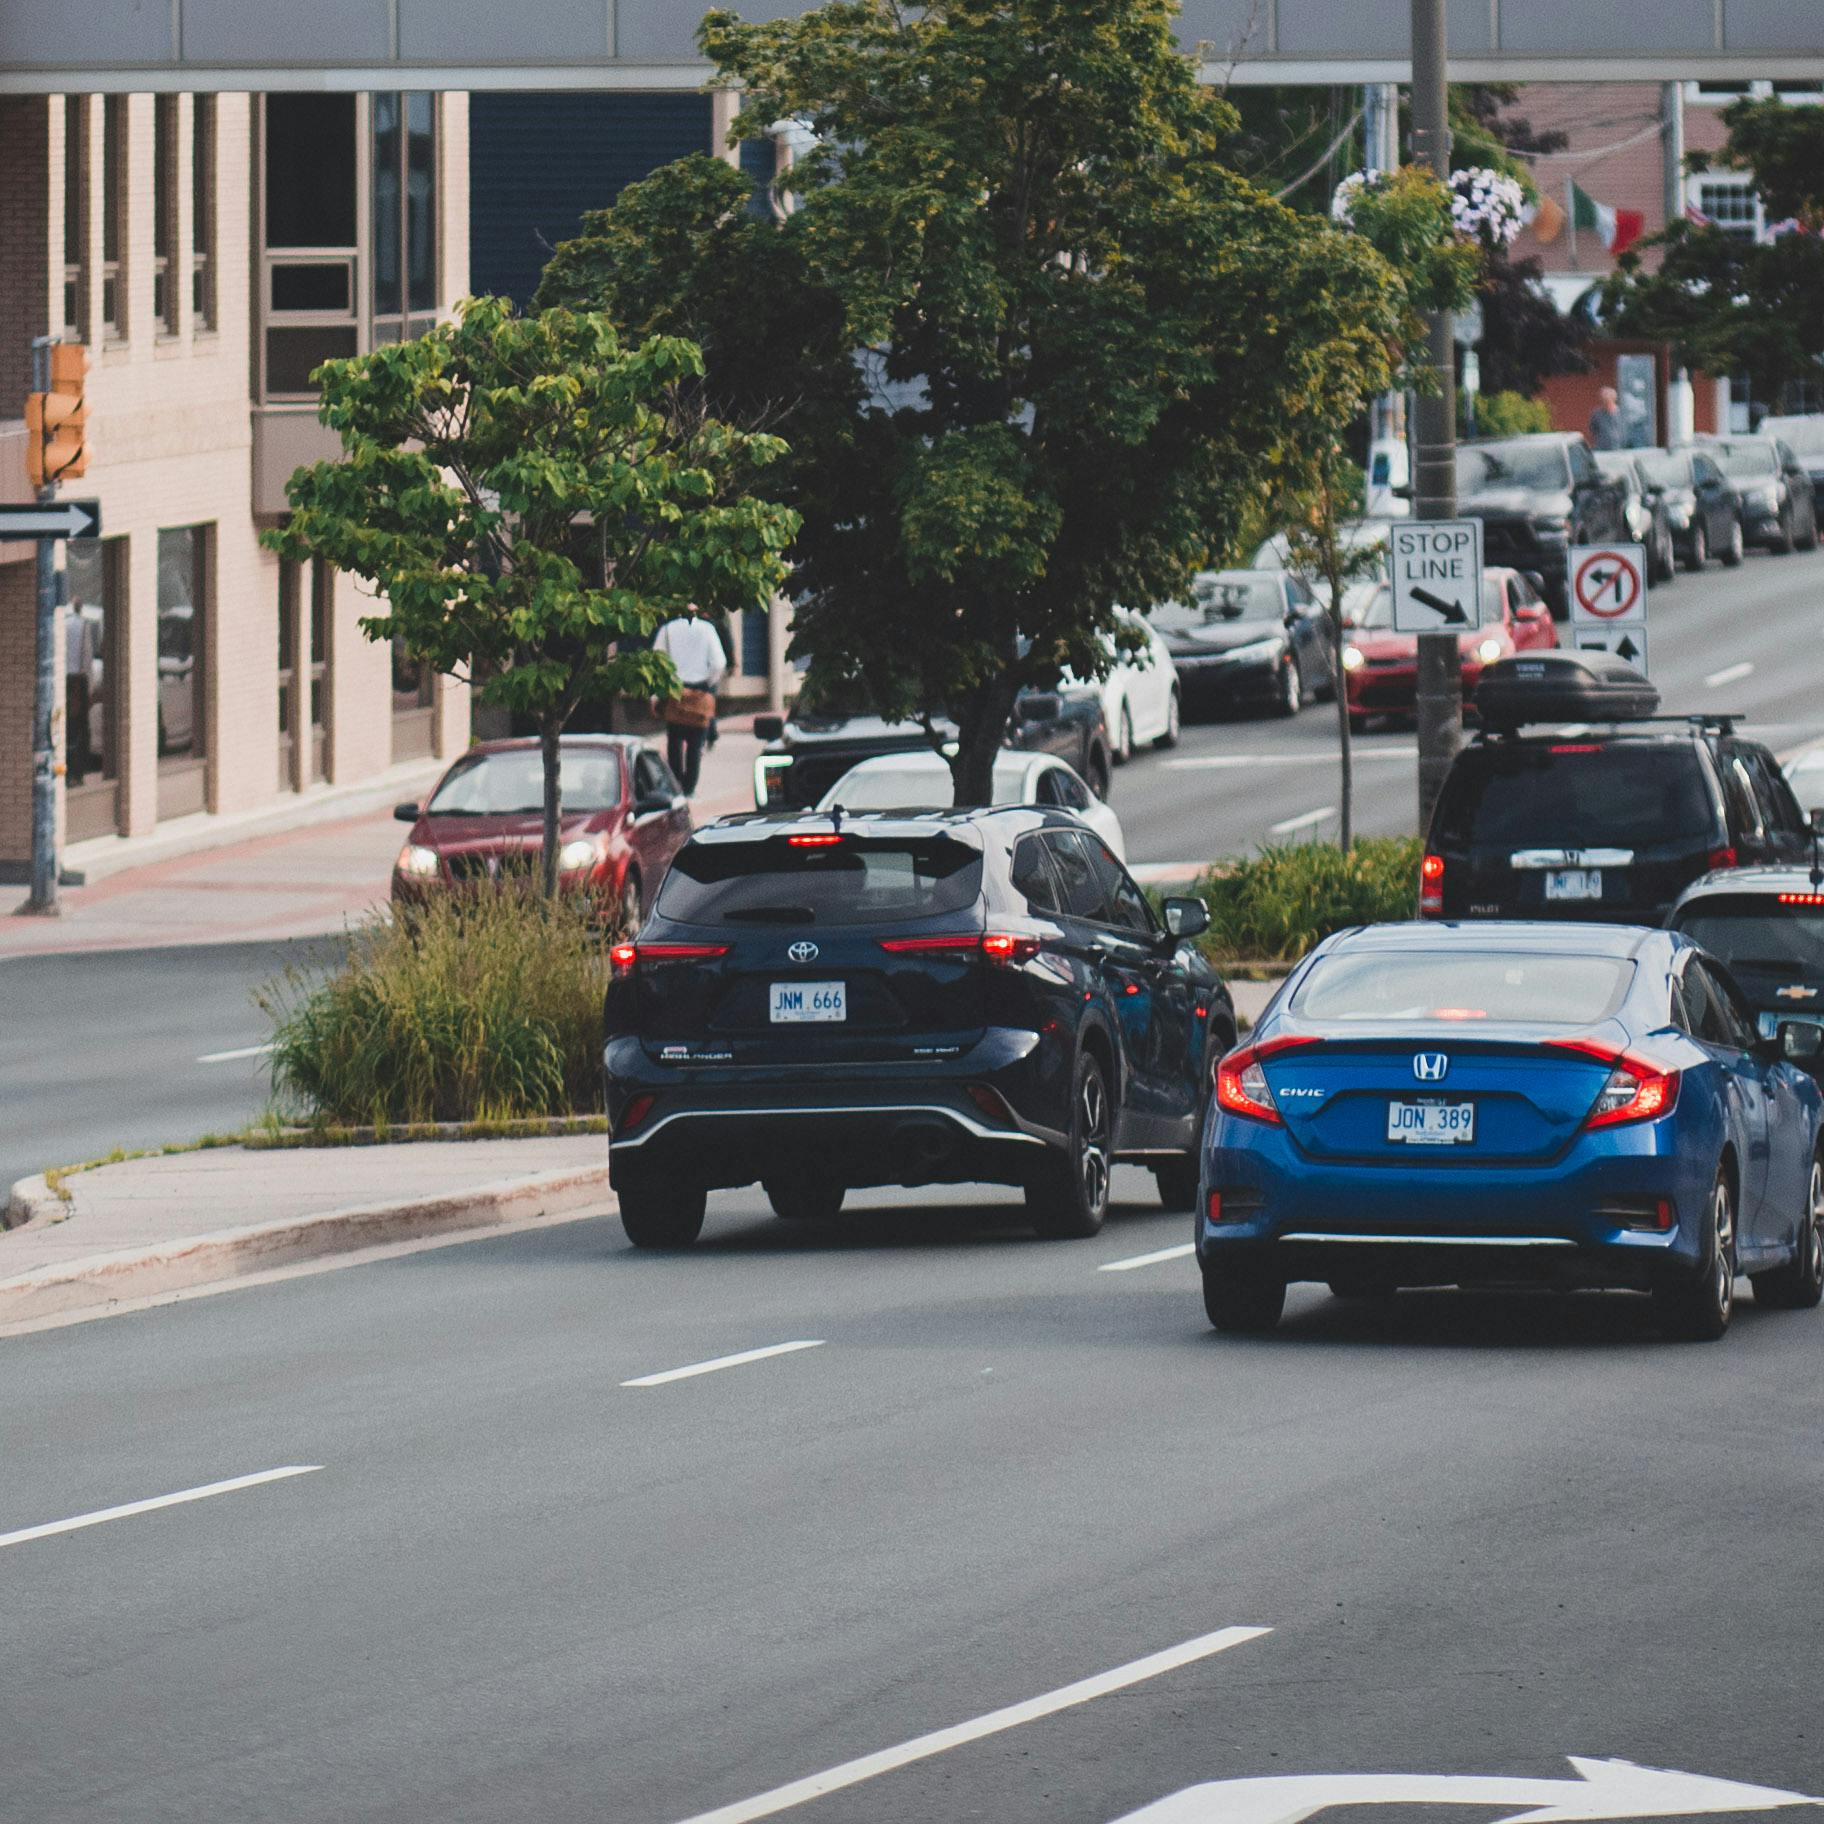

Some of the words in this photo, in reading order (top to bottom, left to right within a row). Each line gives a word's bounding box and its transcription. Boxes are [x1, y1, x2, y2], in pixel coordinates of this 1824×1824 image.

[1398, 532, 1470, 555] STOP
[1405, 558, 1464, 581] LINE
[774, 991, 803, 1010] JNM
[813, 990, 842, 1009] 666
[1279, 1088, 1325, 1097] CIVIC
[1392, 1108, 1426, 1128] JON
[1438, 1108, 1472, 1129] 389
